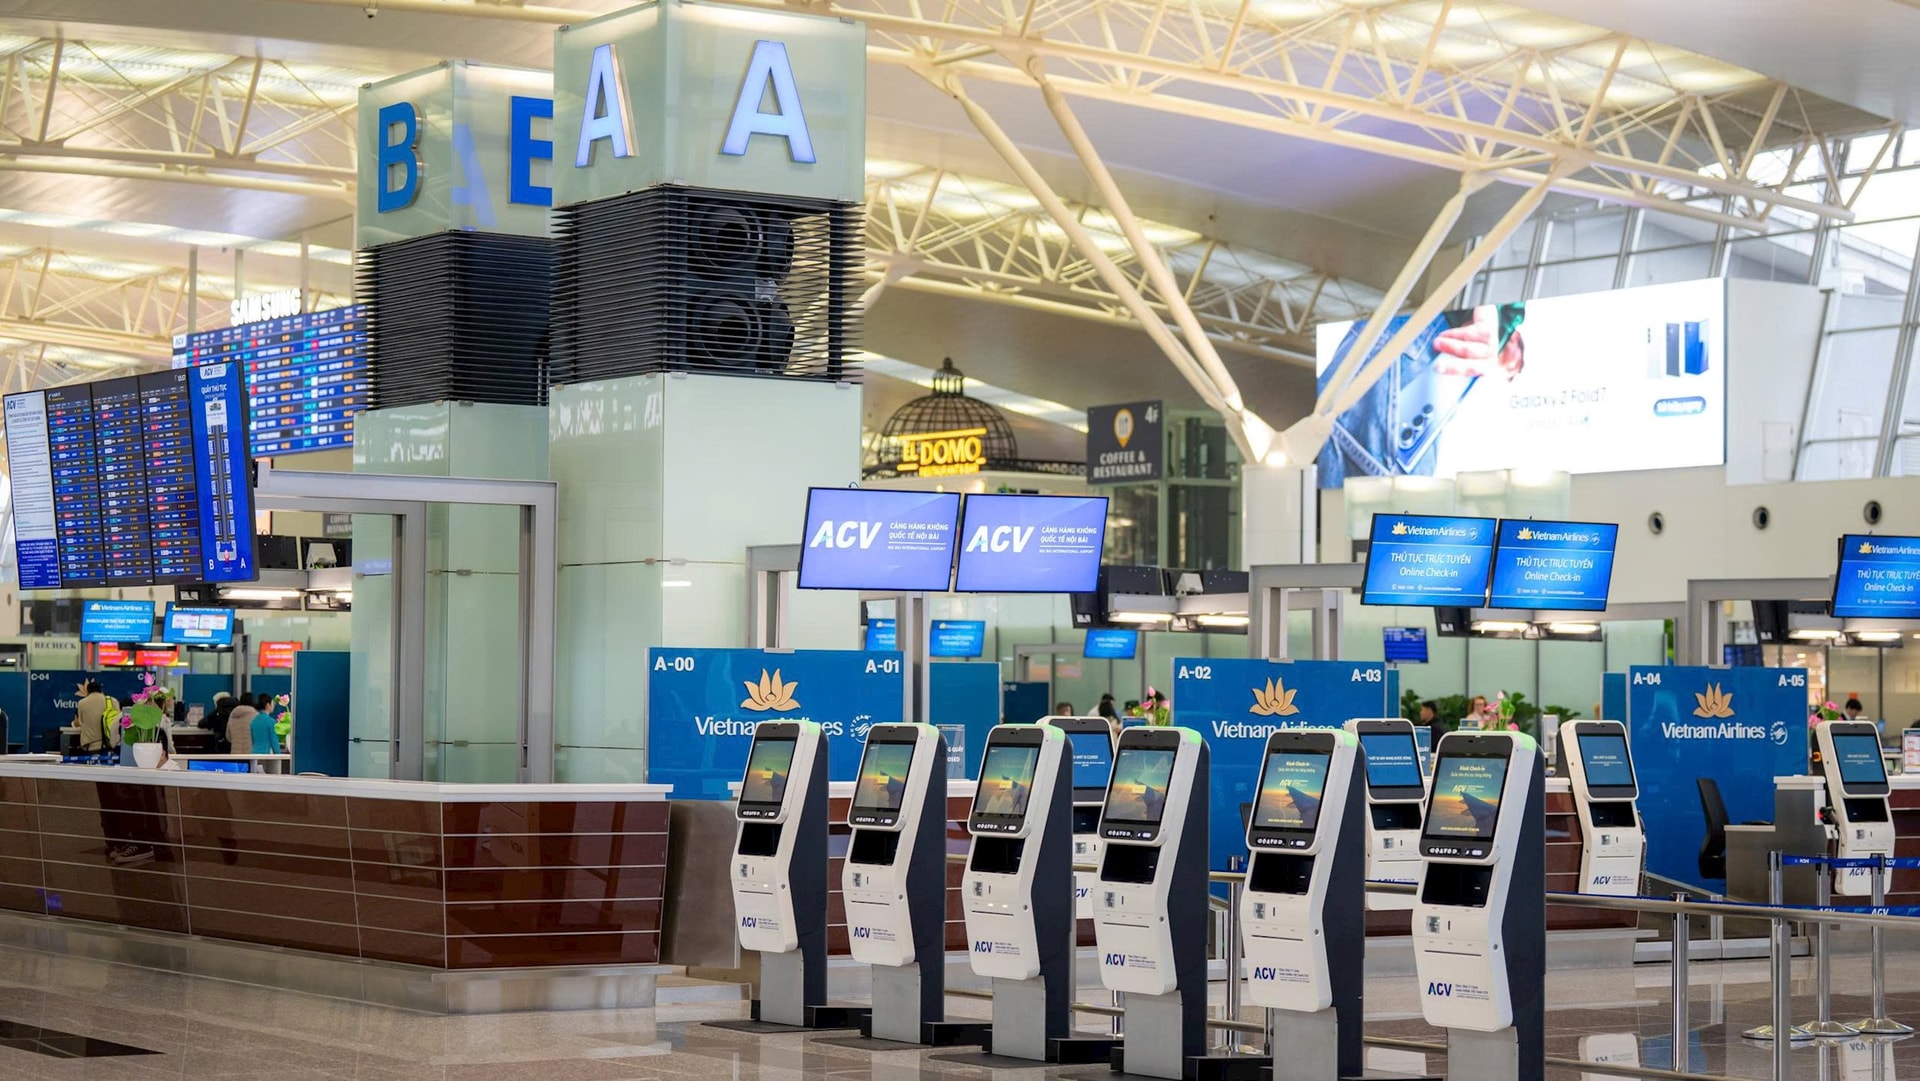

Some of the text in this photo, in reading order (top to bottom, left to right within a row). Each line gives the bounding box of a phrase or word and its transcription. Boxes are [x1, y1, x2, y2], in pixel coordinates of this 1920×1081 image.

[575, 43, 635, 168] A
[718, 40, 817, 164] A
[378, 101, 420, 214] B
[231, 287, 302, 327] SAMSUNG
[1144, 405, 1159, 424] 4F
[903, 436, 982, 466] EL DOMO
[1100, 450, 1145, 465] COFFEE &
[1093, 462, 1152, 478] RESTAURANT
[809, 520, 882, 549] ACV
[965, 525, 1034, 553] ACV
[209, 559, 215, 570] B
[240, 557, 246, 569] A
[1400, 566, 1458, 578] Online Check-in
[1524, 571, 1581, 582] Online Check-in
[1864, 582, 1914, 592] Online Check-in
[34, 641, 77, 650] RECHECK
[654, 656, 695, 672] A-00
[865, 659, 900, 674] A-01
[1178, 666, 1211, 680] A-02
[1351, 668, 1382, 682] A-03
[1634, 672, 1661, 685] A-04
[1778, 674, 1804, 687] A-05
[1593, 876, 1611, 885] ACV
[1075, 888, 1088, 898] CV
[742, 916, 757, 928] ACV
[854, 926, 870, 939] ACV
[975, 940, 992, 953] ACV
[1105, 953, 1126, 966] ACV
[1254, 967, 1276, 980] ACV
[1428, 982, 1452, 996] ACV
